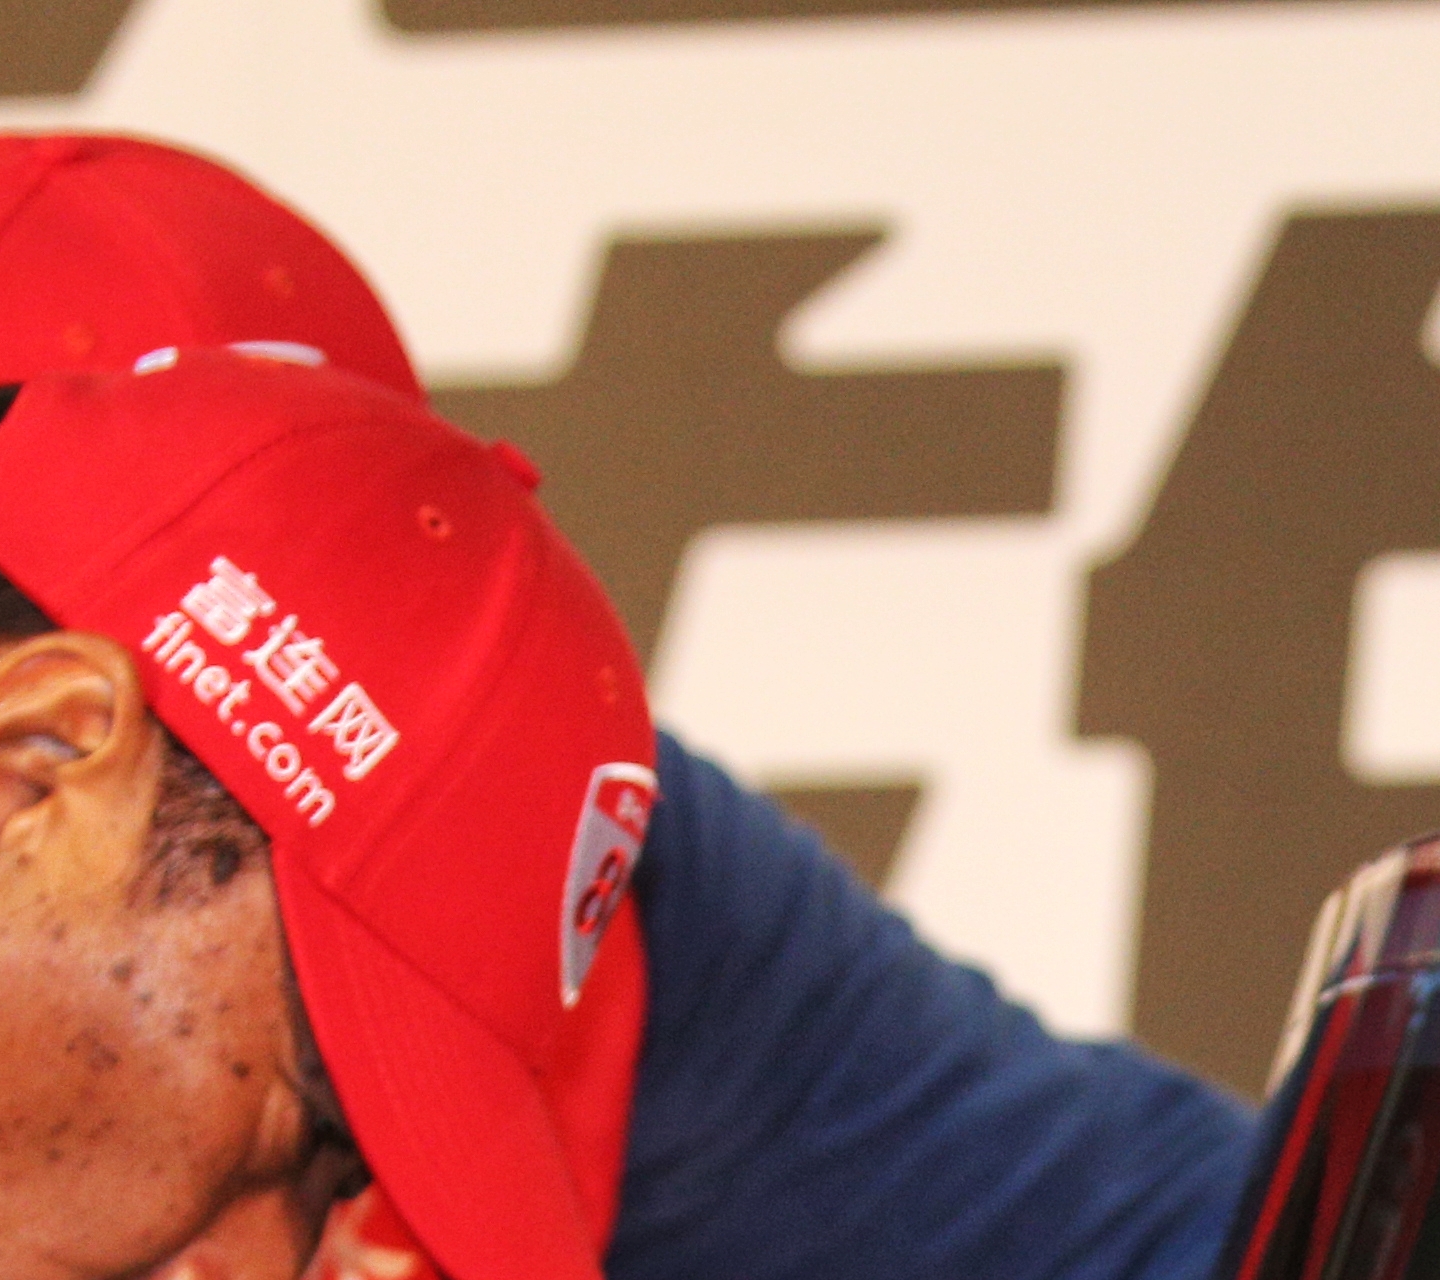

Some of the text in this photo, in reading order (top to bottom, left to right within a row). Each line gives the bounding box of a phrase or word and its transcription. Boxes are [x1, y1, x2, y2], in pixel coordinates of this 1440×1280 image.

[142, 608, 338, 829] flnet.com
[177, 555, 402, 783] 富连网
